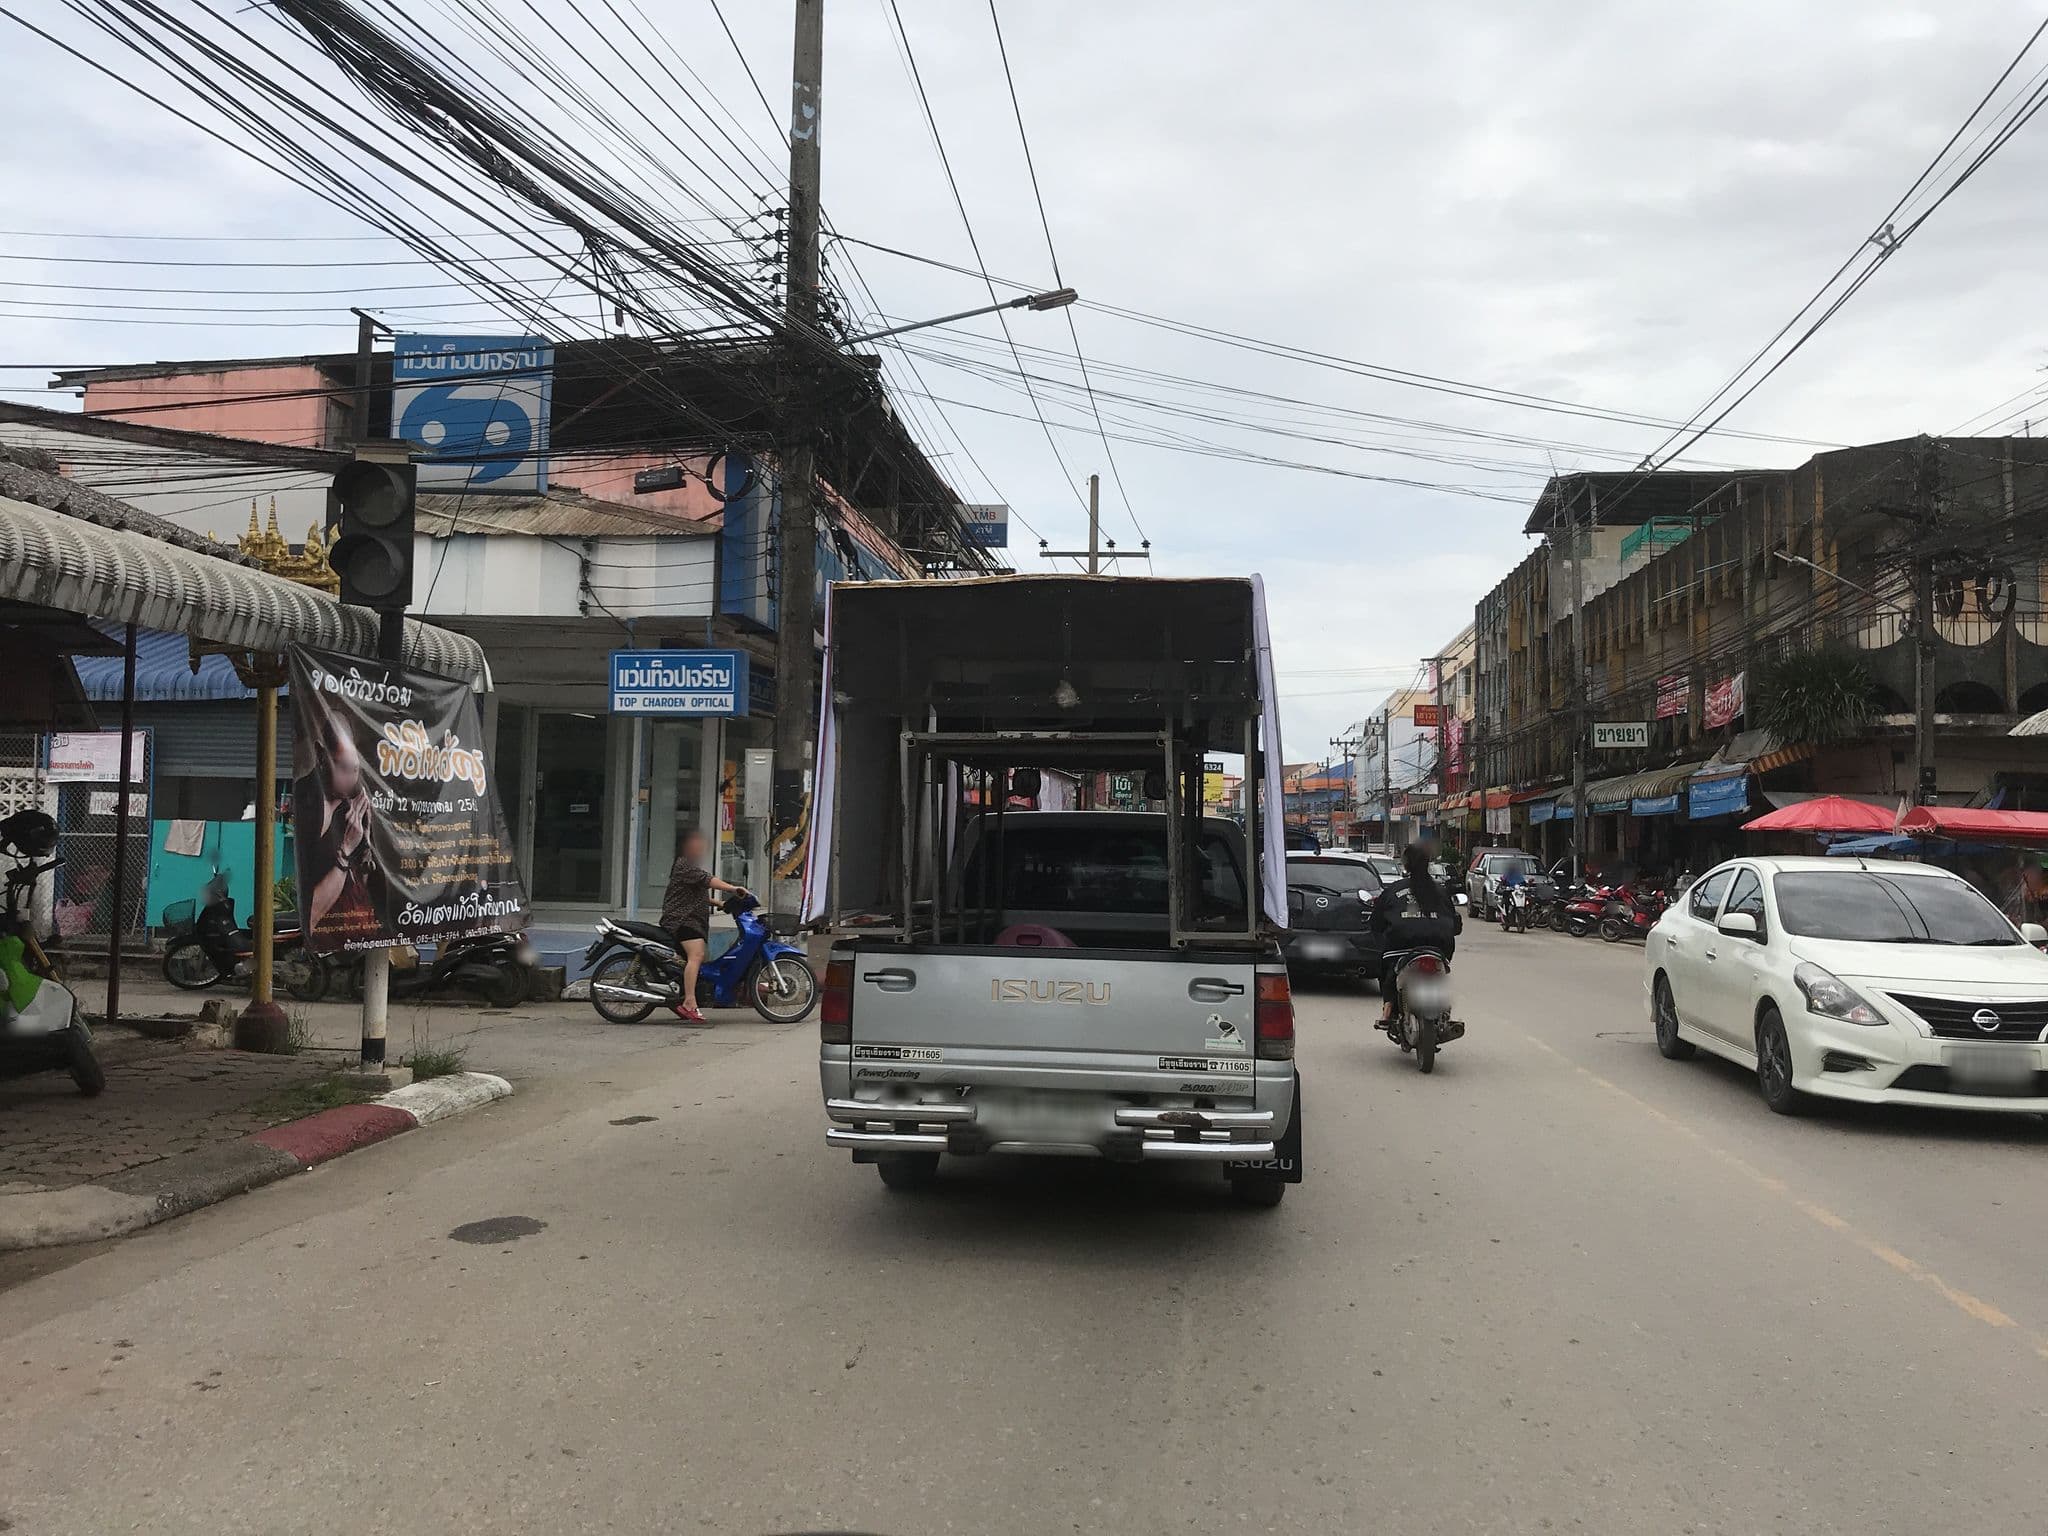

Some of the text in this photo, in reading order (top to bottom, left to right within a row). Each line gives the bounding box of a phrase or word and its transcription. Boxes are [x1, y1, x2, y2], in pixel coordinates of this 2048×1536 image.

[618, 660, 730, 688] แว่นท็อปเจริญ
[311, 667, 412, 707] ขอเชิญร่วม
[619, 697, 730, 708] TOP CHAROEN OPTICAL
[1597, 728, 1645, 743] ขายยา
[398, 797, 408, 812] 12
[991, 979, 1111, 1005] ISUZU
[911, 1049, 941, 1059] 711605
[1220, 1061, 1250, 1071] 711605
